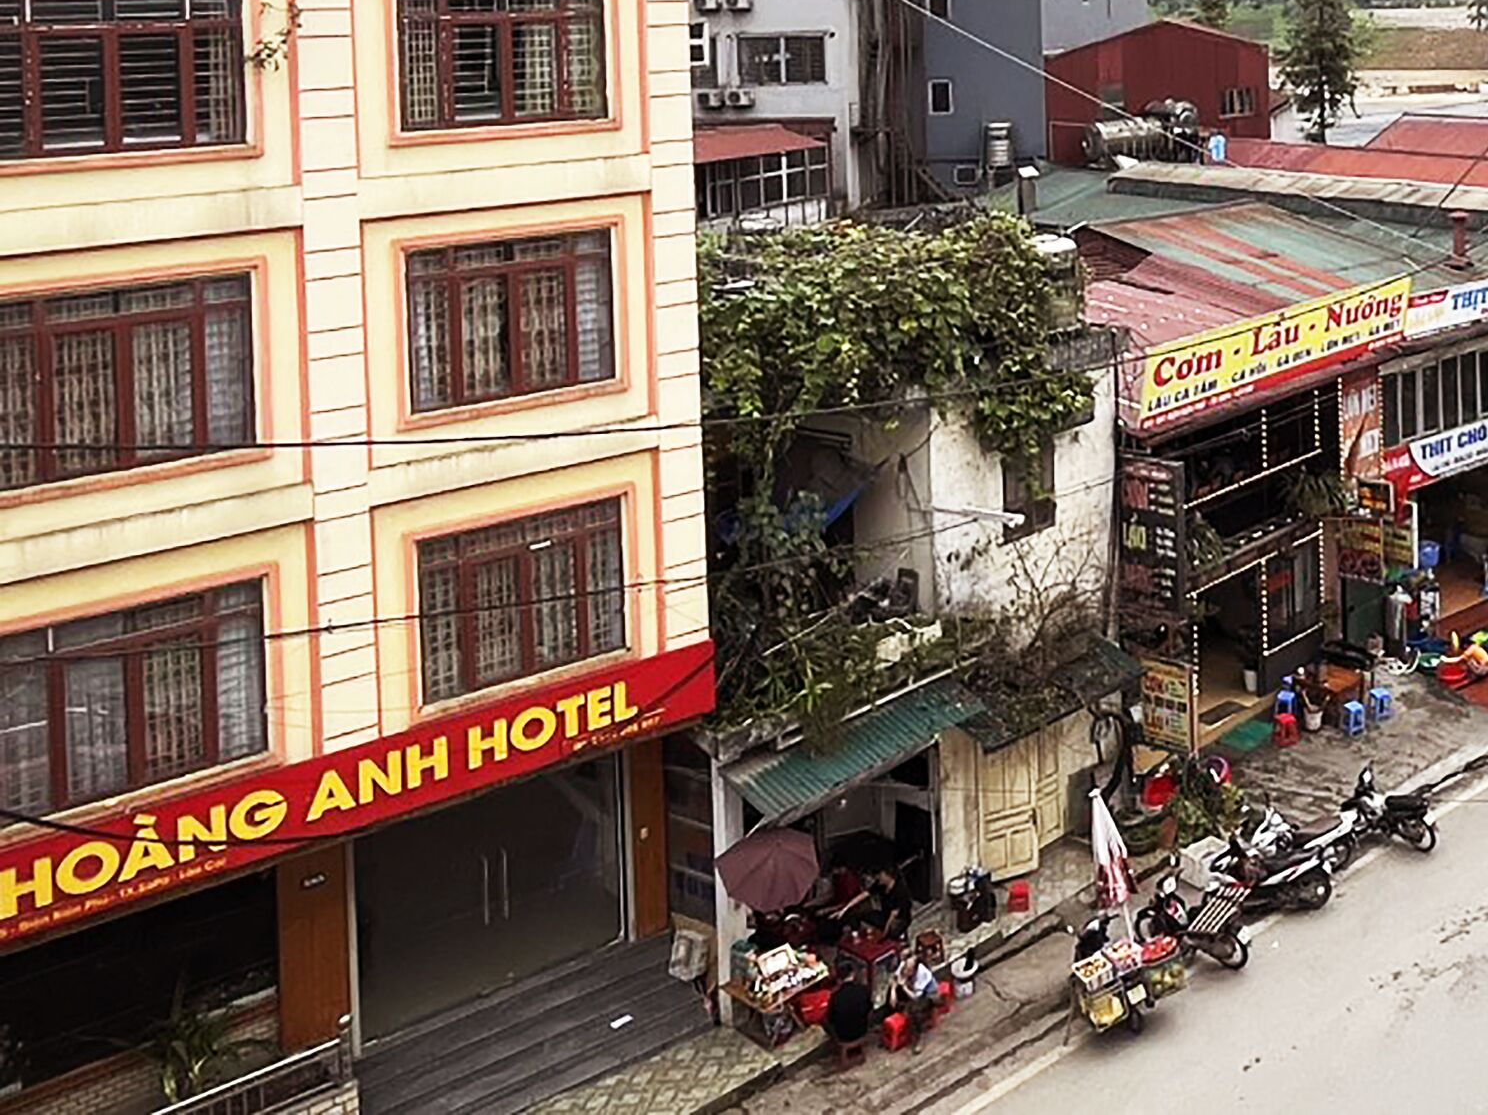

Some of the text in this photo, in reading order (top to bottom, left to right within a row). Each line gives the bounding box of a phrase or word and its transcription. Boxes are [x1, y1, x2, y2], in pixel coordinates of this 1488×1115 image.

[0, 791, 288, 921] HOÀNG
[305, 736, 449, 822] ANH
[467, 681, 639, 771] HOTEL
